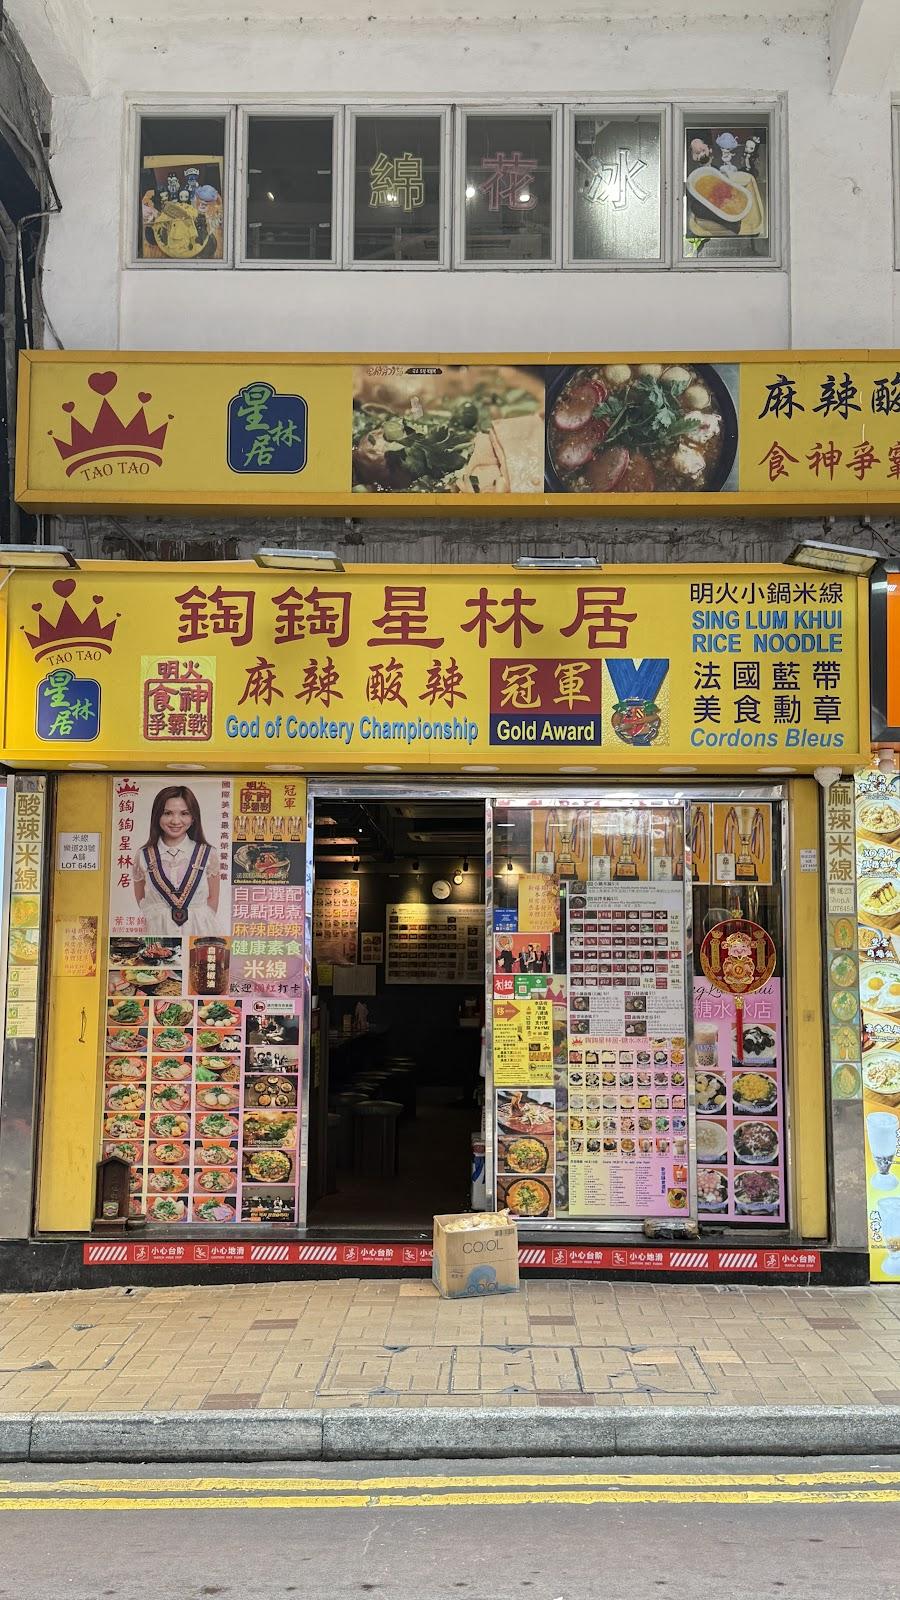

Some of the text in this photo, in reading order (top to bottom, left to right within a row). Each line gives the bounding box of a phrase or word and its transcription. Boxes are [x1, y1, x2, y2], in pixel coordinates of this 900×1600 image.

[80, 462, 150, 481] TAO TAO
[690, 582, 843, 604] 明火小鍋米線
[691, 610, 842, 630] SING LUM KHUI
[692, 633, 843, 653] RICE NOODLE
[46, 650, 102, 667] TAO TAO
[157, 660, 203, 679] 明火
[693, 661, 841, 691] 法國藍帶
[237, 656, 467, 709] 麻辣酸辣
[500, 662, 592, 710] 冠軍
[148, 683, 209, 713] 食神
[693, 694, 841, 724] 美食勳章
[149, 713, 209, 736] 爭霸戰
[225, 714, 479, 745] God of Cookery Championship
[497, 719, 595, 741] Gold Award
[690, 727, 844, 748] Cordons Bleus
[827, 782, 853, 881] 麻辣米線
[15, 794, 41, 891] 酸辣米線
[234, 887, 303, 902] 自己選配
[233, 904, 302, 919] 現點現煮
[232, 922, 303, 937] 麻辣酸辣
[231, 940, 302, 956] 健康素食
[244, 960, 288, 979] 米線
[151, 1246, 185, 1255] 小心台阶
[211, 1246, 245, 1255] 小心地滑
[360, 1248, 394, 1257] 小心台阶
[569, 1251, 603, 1259] 小心台阶
[629, 1252, 663, 1261] 小心地滑
[782, 1254, 816, 1263] 小心台阶
